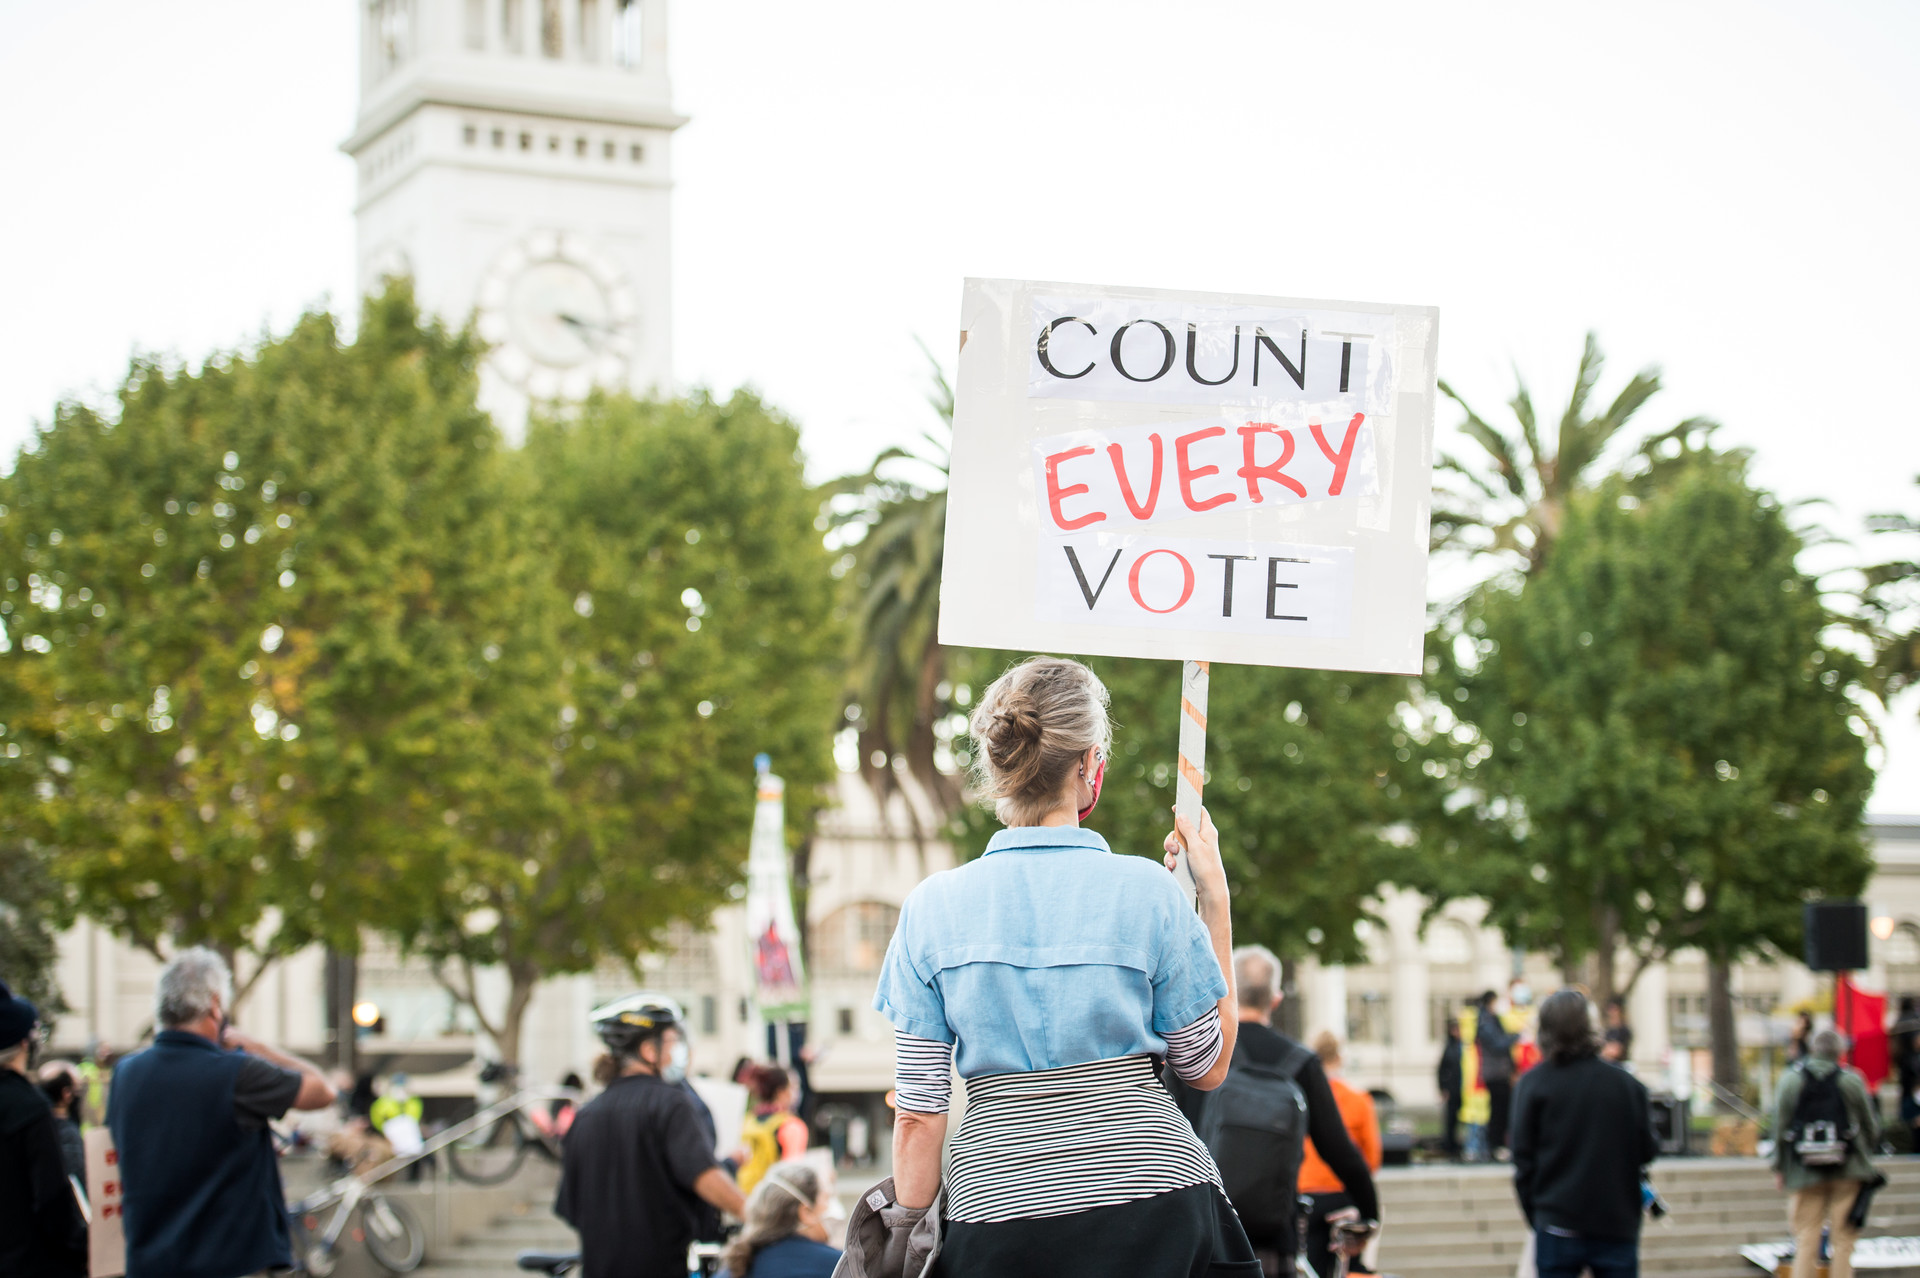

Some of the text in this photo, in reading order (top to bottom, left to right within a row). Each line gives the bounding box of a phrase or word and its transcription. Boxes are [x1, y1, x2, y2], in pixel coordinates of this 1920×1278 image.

[1037, 316, 1374, 393] COUNT
[1045, 412, 1366, 531] EVERY
[1063, 545, 1311, 621] VOTE
